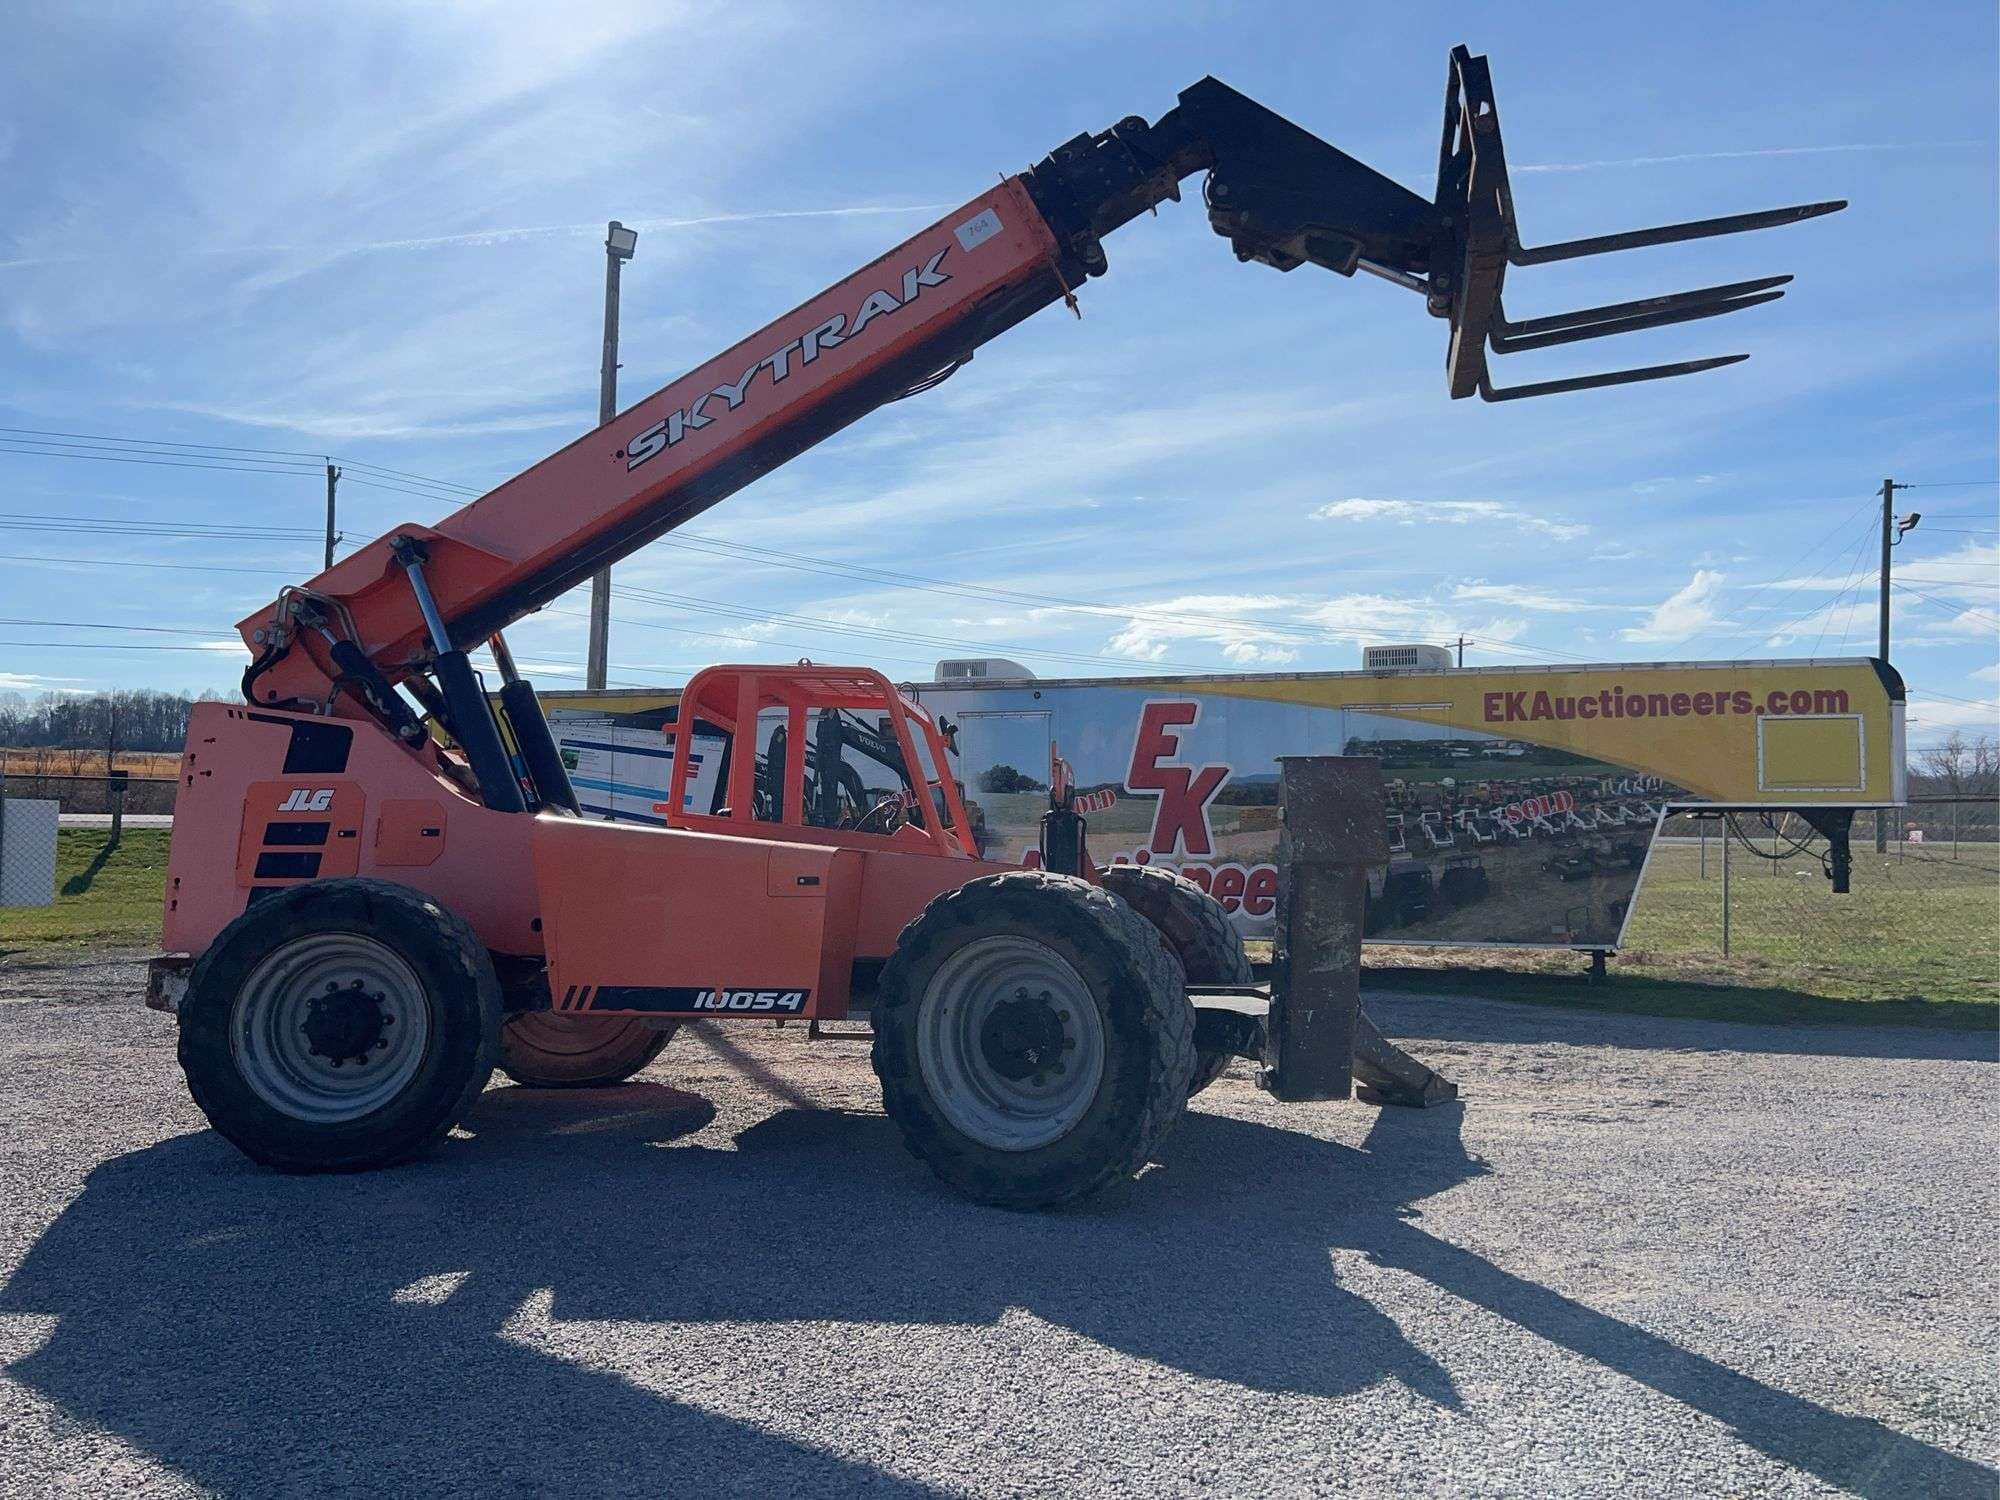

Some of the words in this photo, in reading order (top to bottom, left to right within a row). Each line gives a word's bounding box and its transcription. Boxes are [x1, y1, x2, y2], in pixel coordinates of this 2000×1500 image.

[625, 245, 953, 473] SKYTRAK
[1483, 685, 1850, 723] EKAuctioneers.com
[858, 734, 888, 753] VOLVO
[276, 788, 336, 812] JLG
[1072, 789, 1117, 815] OLD
[1505, 790, 1575, 825] SOLD
[693, 991, 802, 1011] 10054
